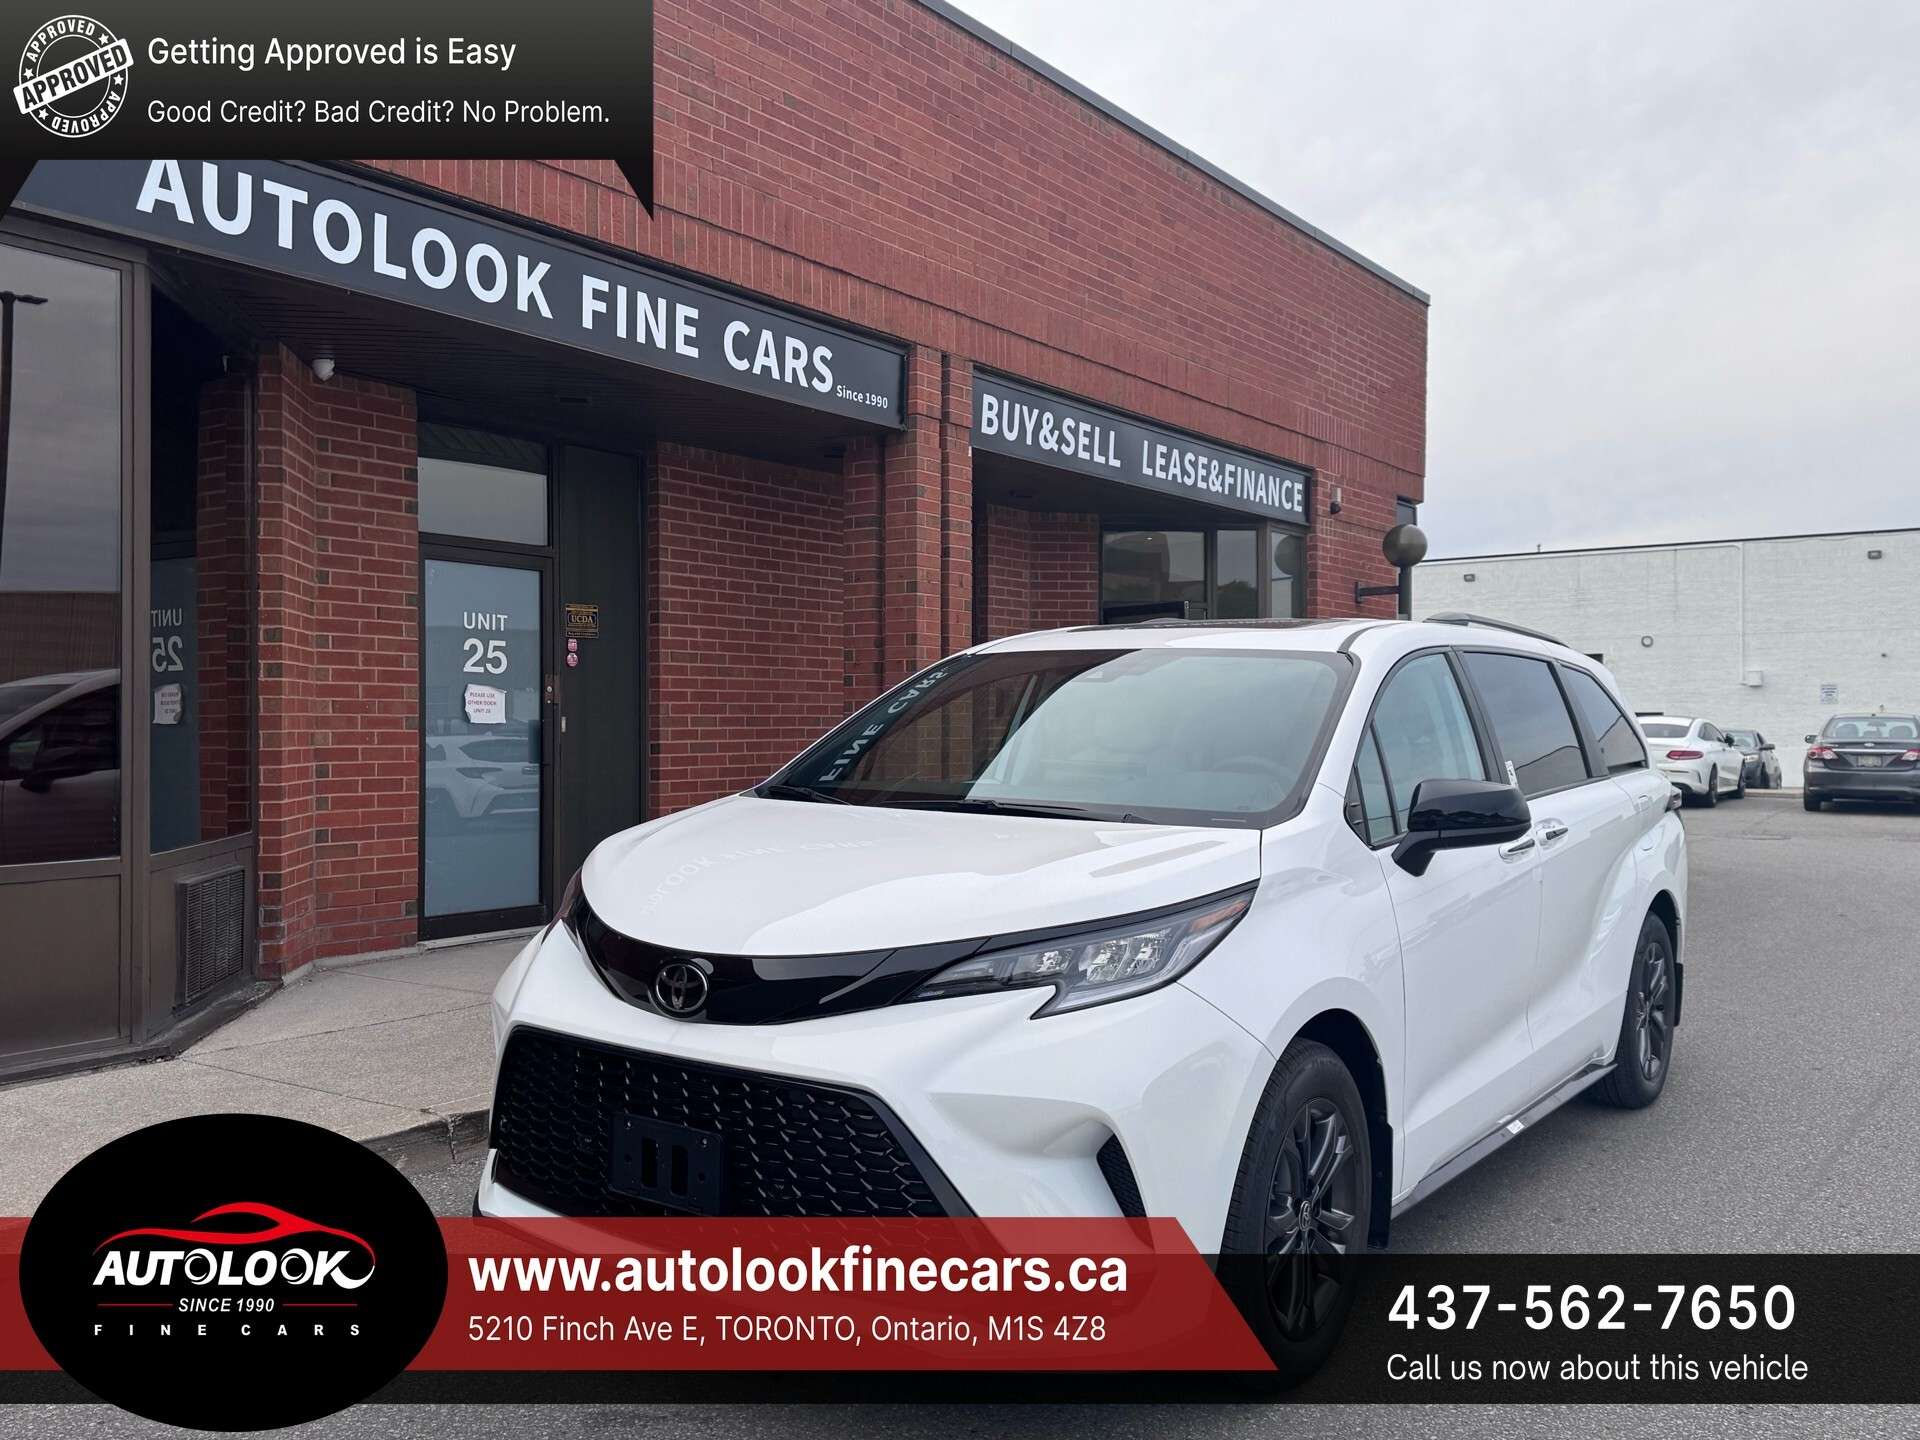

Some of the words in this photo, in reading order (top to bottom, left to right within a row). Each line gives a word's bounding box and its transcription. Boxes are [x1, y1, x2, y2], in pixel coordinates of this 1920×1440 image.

[136, 160, 553, 319] AUTOLOOK
[582, 274, 699, 359] FINE
[724, 320, 833, 393] CARS
[836, 384, 864, 403] Since
[865, 392, 888, 409] 1990
[981, 393, 1121, 468] BUY&SELL
[1142, 440, 1304, 513] LEASE&FINANCE
[463, 611, 509, 631] UNIT
[463, 637, 508, 675] 25
